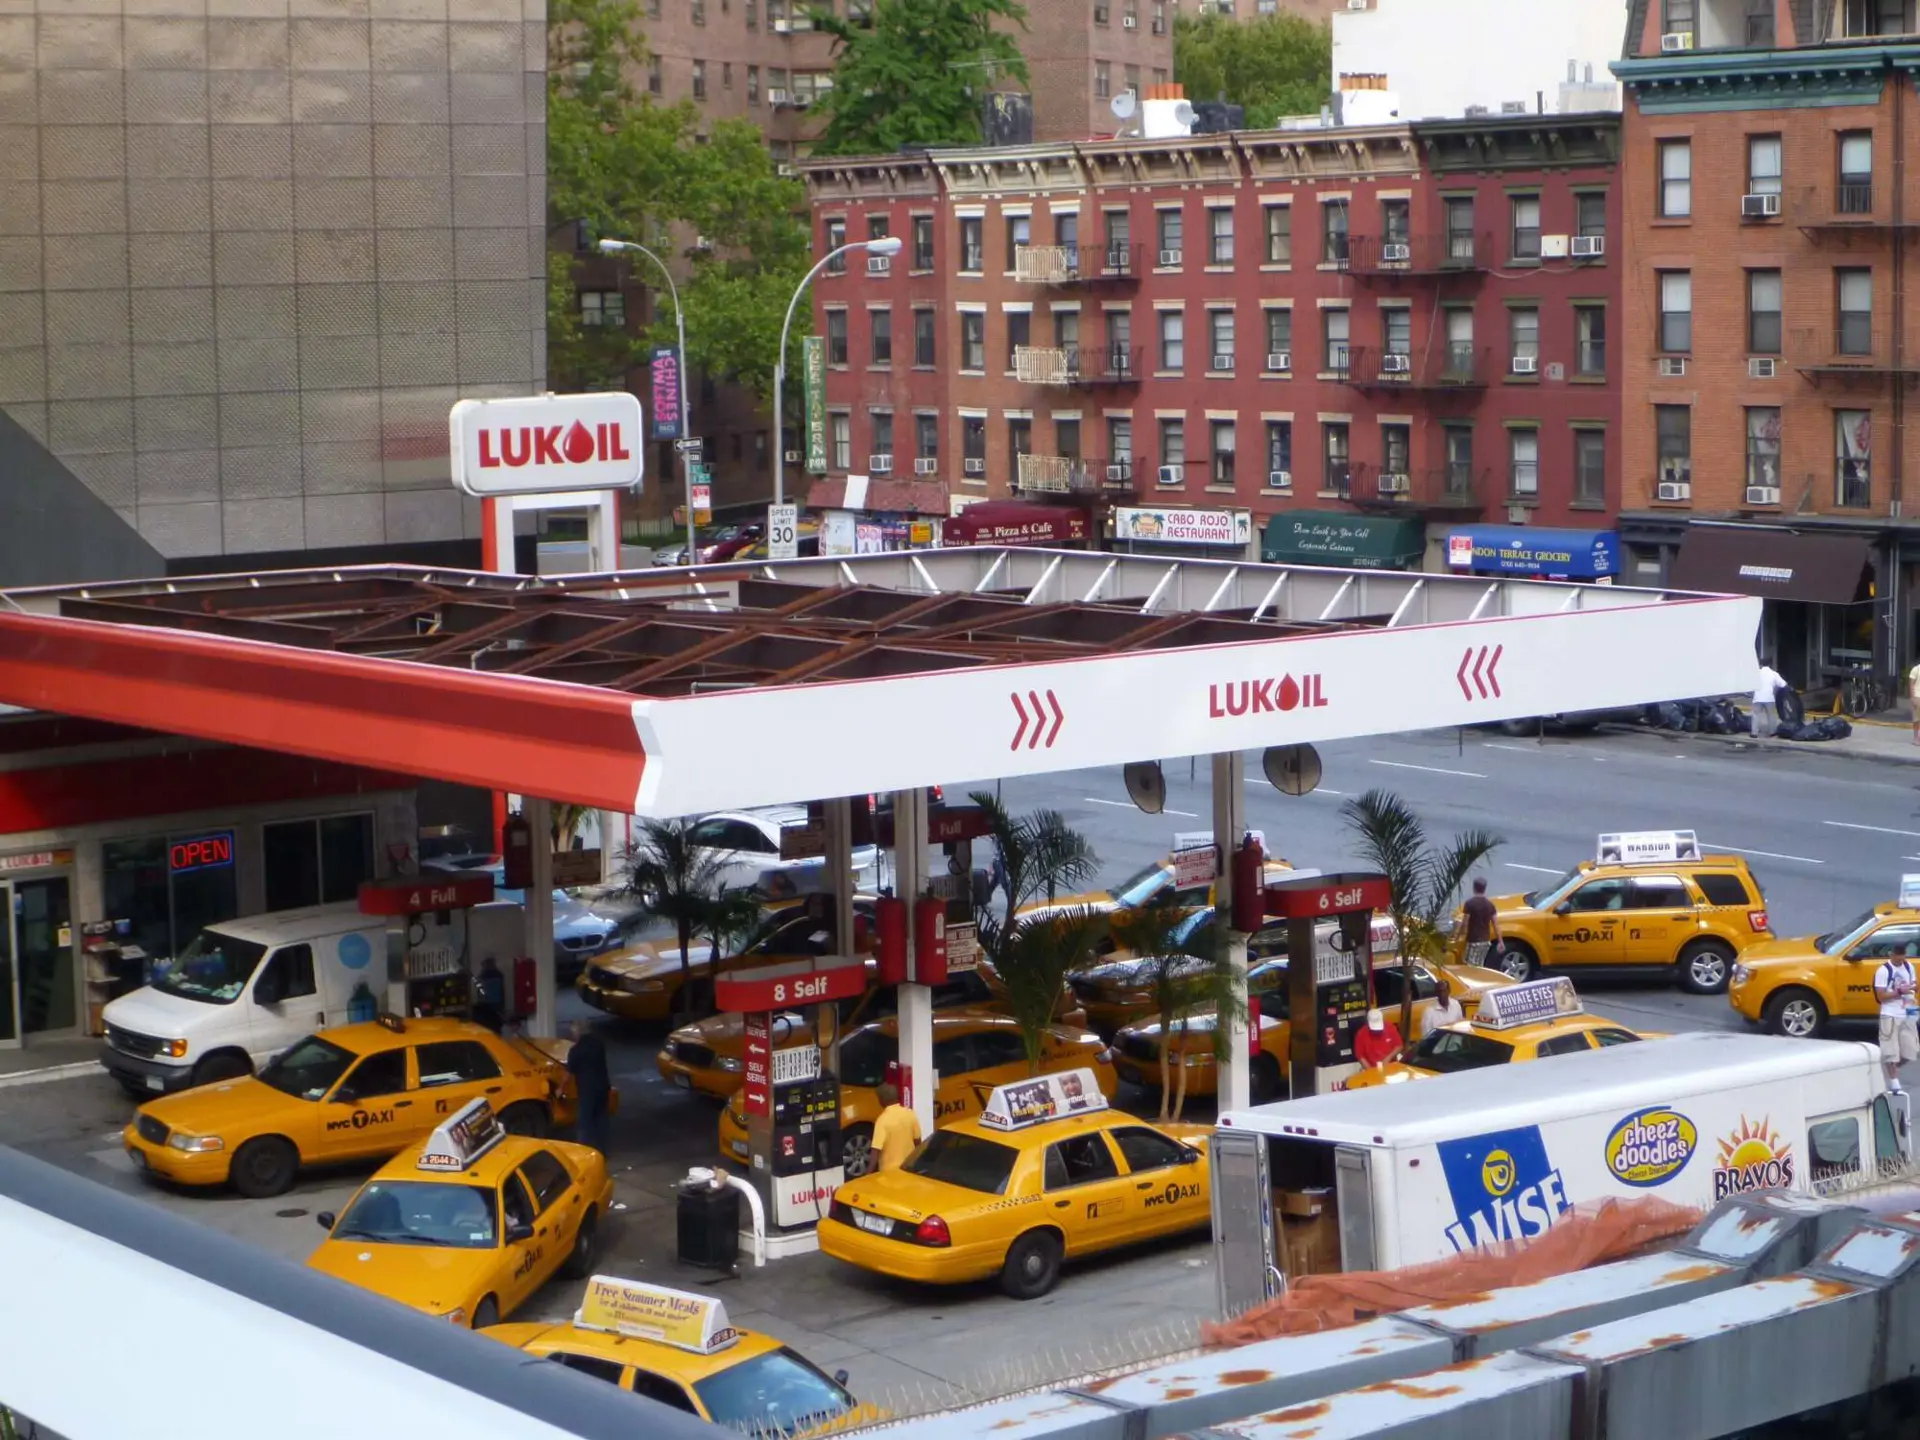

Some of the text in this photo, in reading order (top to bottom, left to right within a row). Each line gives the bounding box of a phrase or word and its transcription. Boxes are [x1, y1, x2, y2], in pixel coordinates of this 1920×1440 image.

[478, 418, 630, 468] LUKOIL
[771, 508, 795, 517] SPEED
[773, 517, 792, 526] LIMIT
[1167, 513, 1228, 527] CABO ROJO
[771, 526, 794, 544] 30
[995, 526, 1020, 538] Pizza
[1021, 524, 1030, 534] &
[1167, 526, 1231, 540] RESTAURANT
[1500, 548, 1532, 560] TERRACE
[1535, 550, 1571, 562] GROCERY
[1209, 672, 1328, 718] LUKOIL
[940, 820, 962, 836] Full
[171, 838, 229, 869] OPEN
[410, 887, 456, 906] 4 Full
[1319, 888, 1363, 909] 6 Self
[1575, 928, 1613, 943] TAXI
[774, 976, 828, 1001] 8 Self
[1497, 985, 1554, 1009] PRIVATE EYES
[748, 1061, 764, 1072] SELF
[327, 1109, 394, 1131] NYC TAXI
[1624, 1116, 1680, 1147] cheez
[1614, 1138, 1690, 1173] doodles
[1713, 1154, 1793, 1200] BRAVOS
[1144, 1182, 1200, 1208] NYC TAXI
[1446, 1170, 1572, 1257] WISE
[594, 1283, 700, 1316] Free Summer Meals
